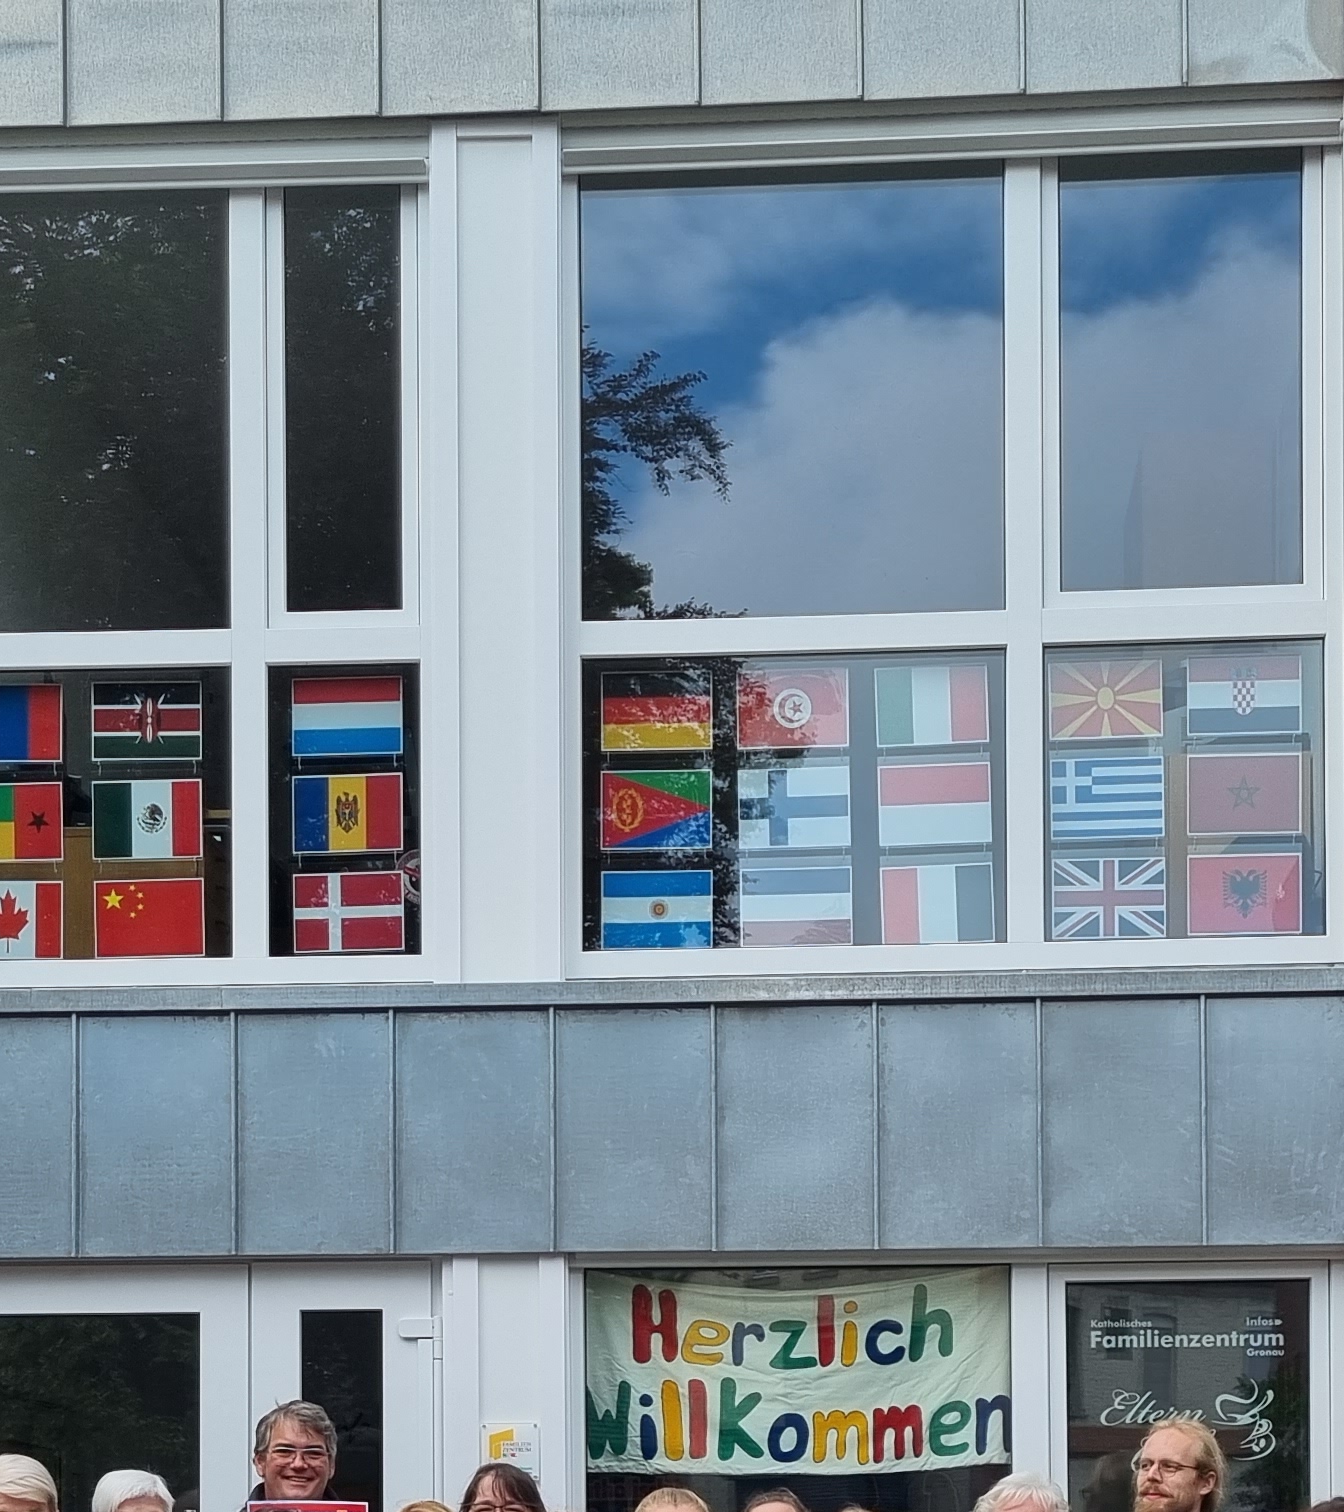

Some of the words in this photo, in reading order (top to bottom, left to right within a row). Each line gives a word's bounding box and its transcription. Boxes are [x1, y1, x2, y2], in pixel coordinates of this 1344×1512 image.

[631, 1283, 954, 1369] Herzlich
[1090, 1319, 1152, 1328] Katholisches
[1246, 1317, 1274, 1327] Infos
[1090, 1329, 1285, 1348] Familienzentrum
[1246, 1348, 1285, 1357] Gronau
[586, 1377, 1011, 1466] Willkommen
